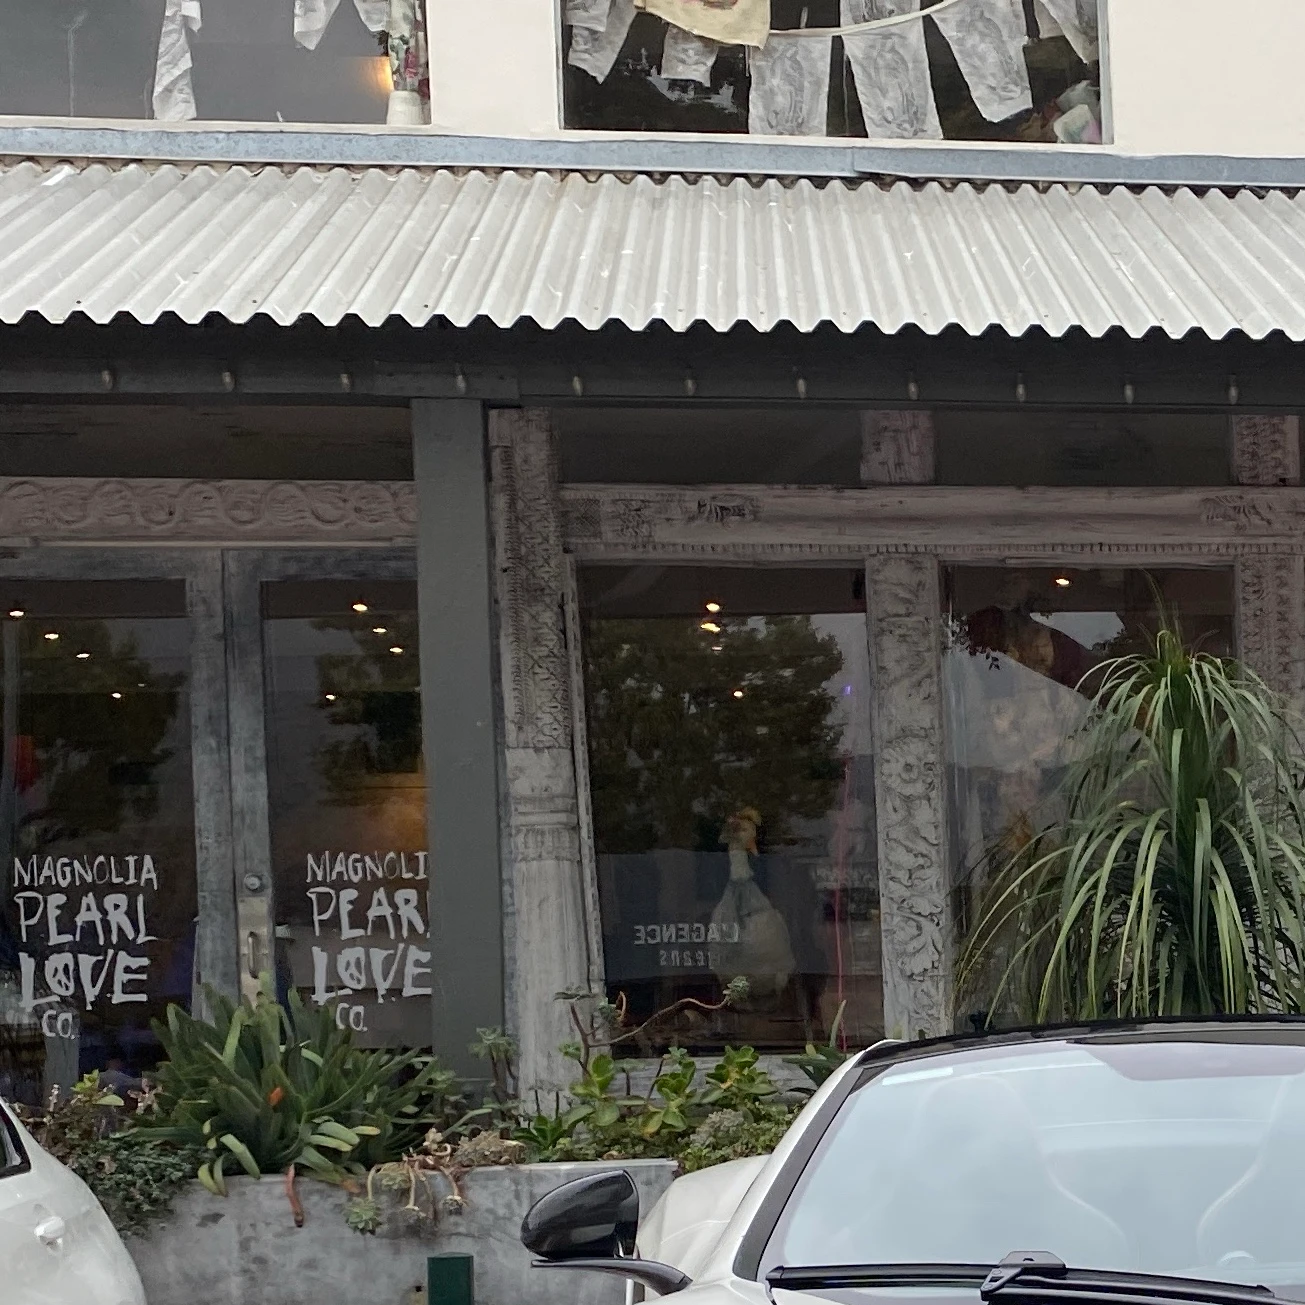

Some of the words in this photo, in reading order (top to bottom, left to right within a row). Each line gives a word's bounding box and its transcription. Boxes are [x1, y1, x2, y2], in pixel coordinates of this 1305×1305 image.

[13, 854, 158, 890] MAGNOLIA
[306, 850, 428, 883] MAGNOLI
[13, 891, 159, 945] PEARL
[18, 948, 150, 1012] LOVE
[311, 943, 432, 1006] LOVE
